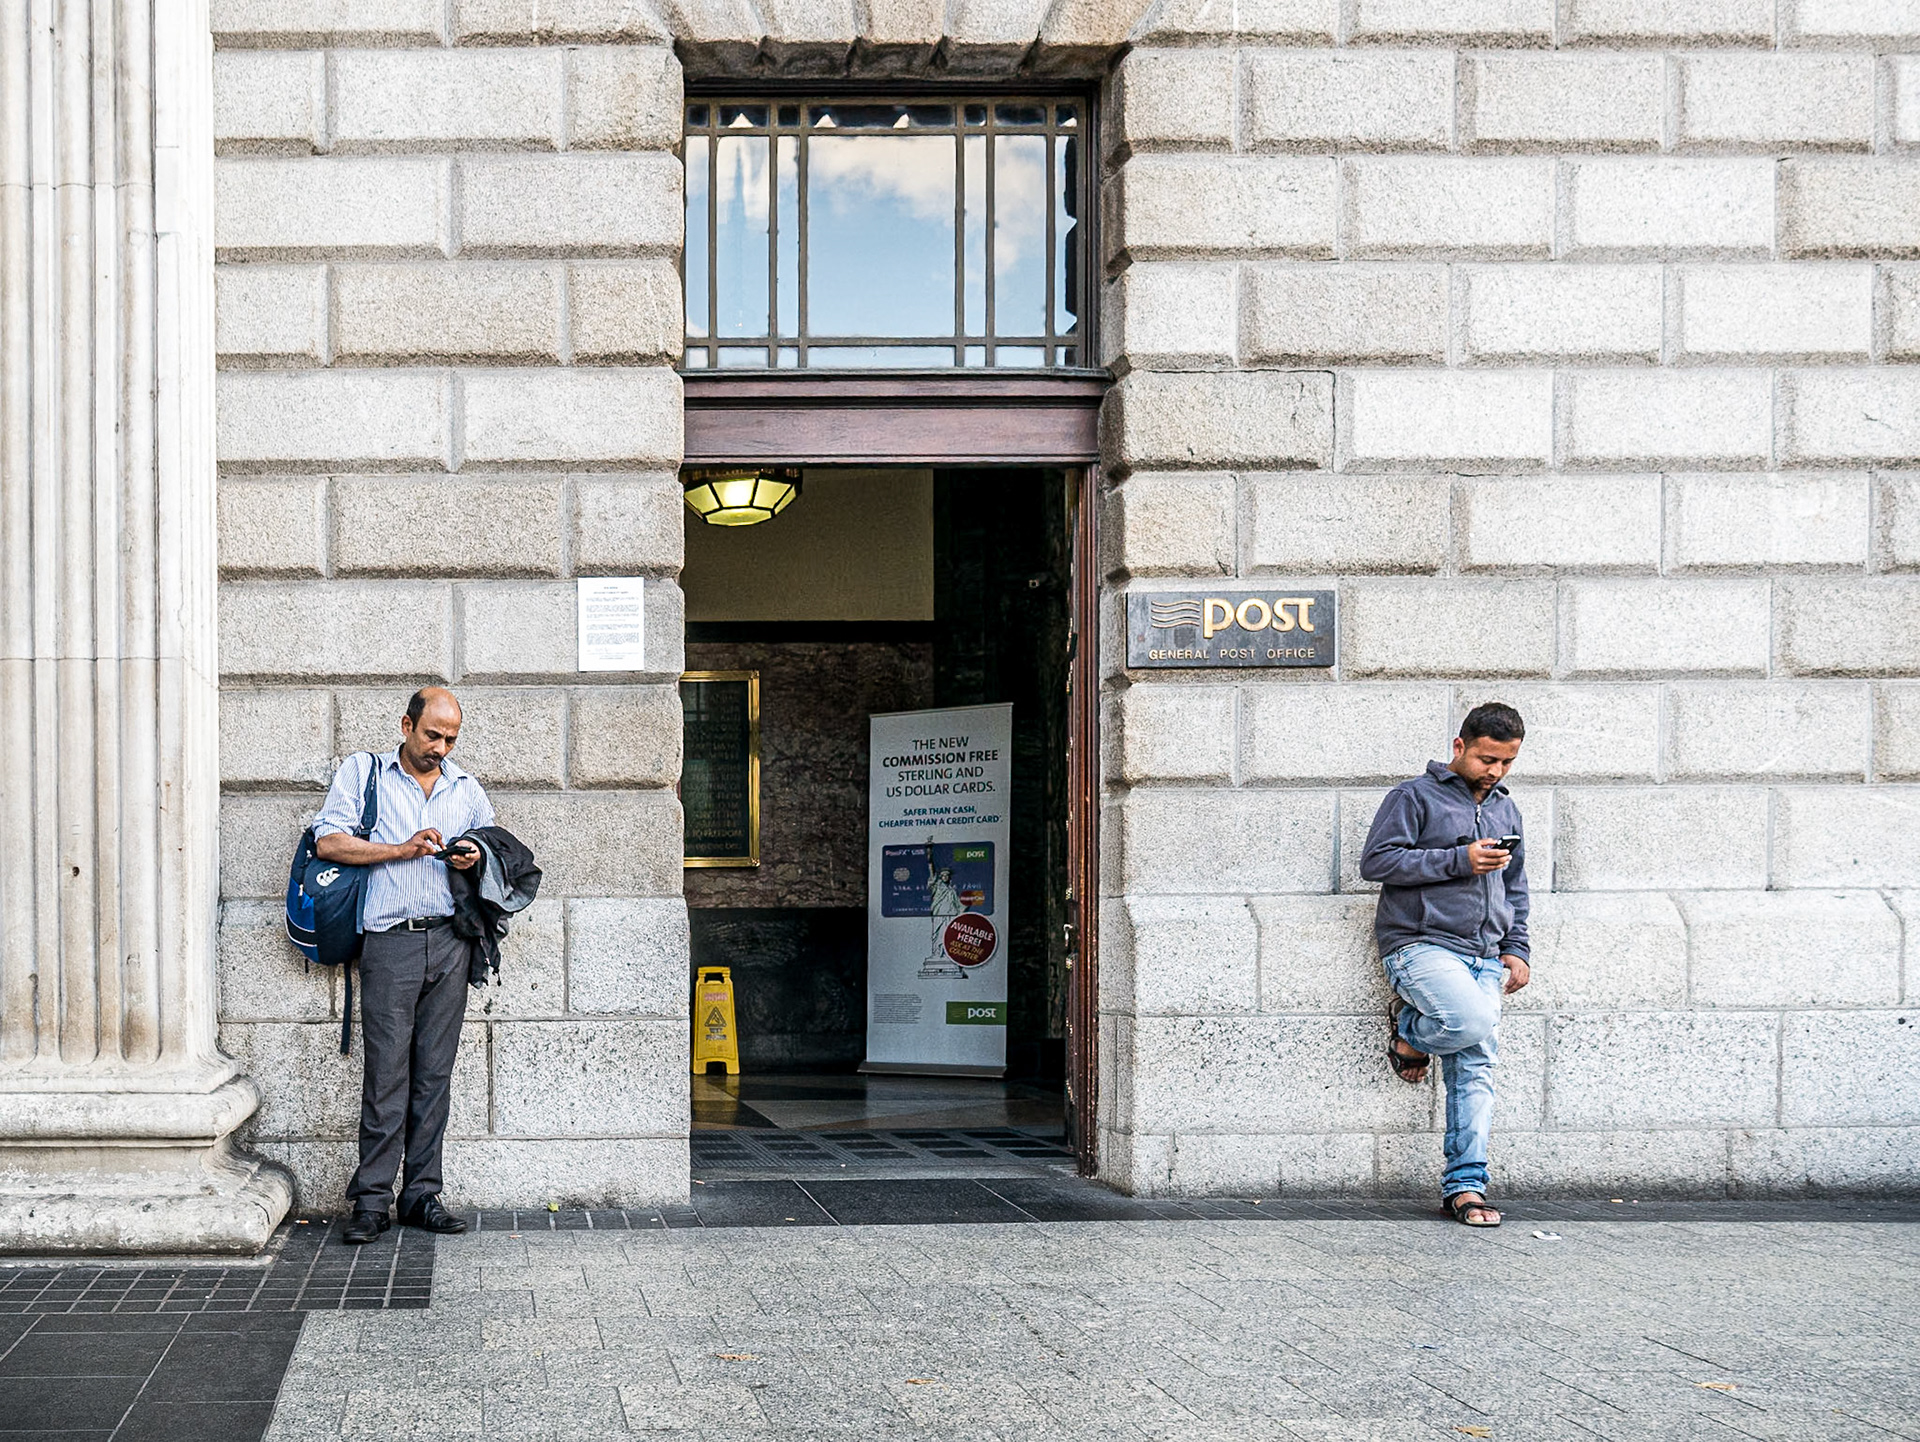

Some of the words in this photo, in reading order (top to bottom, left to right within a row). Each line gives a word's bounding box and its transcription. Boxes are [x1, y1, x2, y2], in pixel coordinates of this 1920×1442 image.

[1149, 648, 1210, 660] GENERAL
[1219, 648, 1257, 660] POST
[1266, 647, 1315, 659] OFFICE
[912, 739, 936, 751] THE
[938, 736, 969, 749] NEW
[882, 752, 966, 768] COMMISSION
[898, 768, 953, 782] STERLING
[955, 766, 984, 778] AND
[886, 786, 902, 798] US
[904, 783, 950, 797] DOLLAR
[952, 781, 996, 795] CARDS.
[903, 808, 927, 817] SAFER
[928, 806, 951, 816] THAN
[952, 805, 977, 815] CASH,
[878, 819, 914, 828] CHEAPER
[915, 818, 937, 827] THAN
[938, 818, 946, 826] A
[946, 815, 976, 826] CREDIT
[950, 921, 994, 941] AVAILABLE
[957, 932, 982, 947] HERE!
[967, 1007, 997, 1019] post
